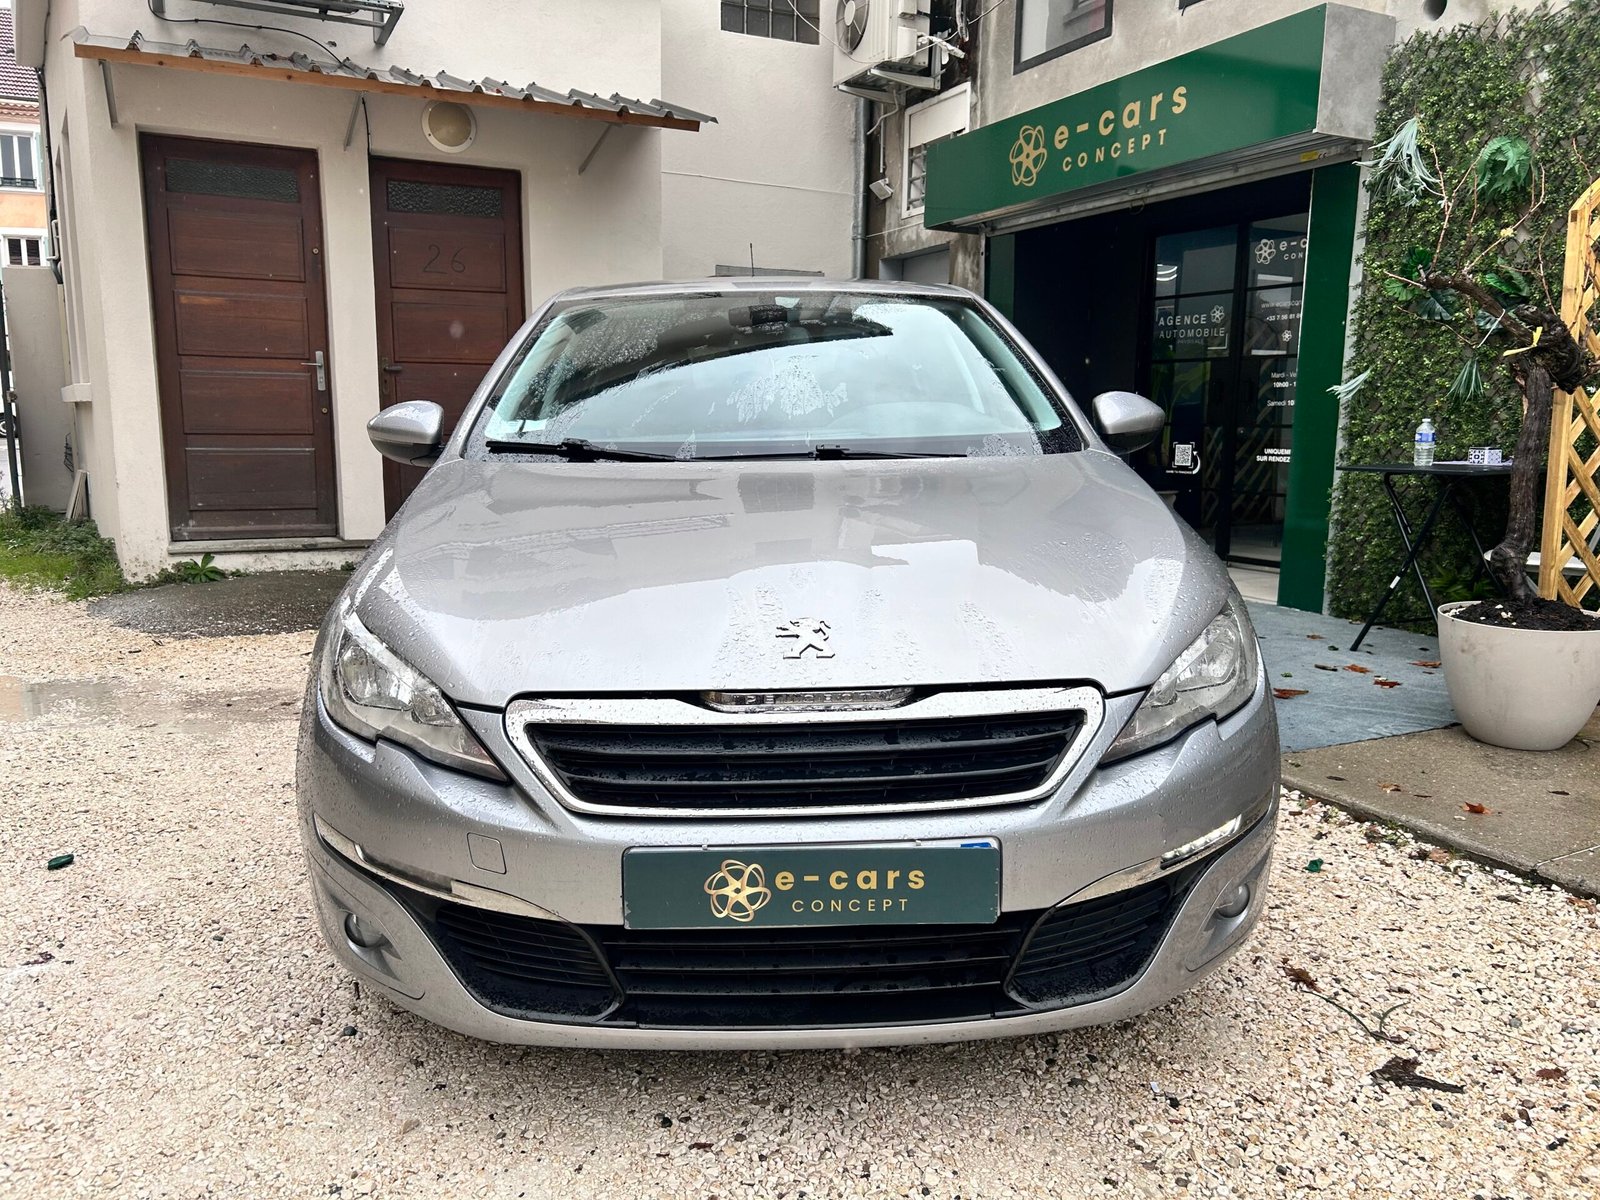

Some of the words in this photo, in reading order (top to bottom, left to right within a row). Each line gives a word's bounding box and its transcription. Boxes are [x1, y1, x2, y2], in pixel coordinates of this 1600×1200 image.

[1053, 86, 1188, 150] e-cars
[1062, 128, 1167, 172] CONCEPT
[422, 244, 466, 275] 26
[1158, 313, 1207, 326] AGENCE
[1159, 327, 1225, 339] AUTOMOBILE
[774, 867, 927, 892] e-cars
[791, 897, 910, 914] CONCEPT
